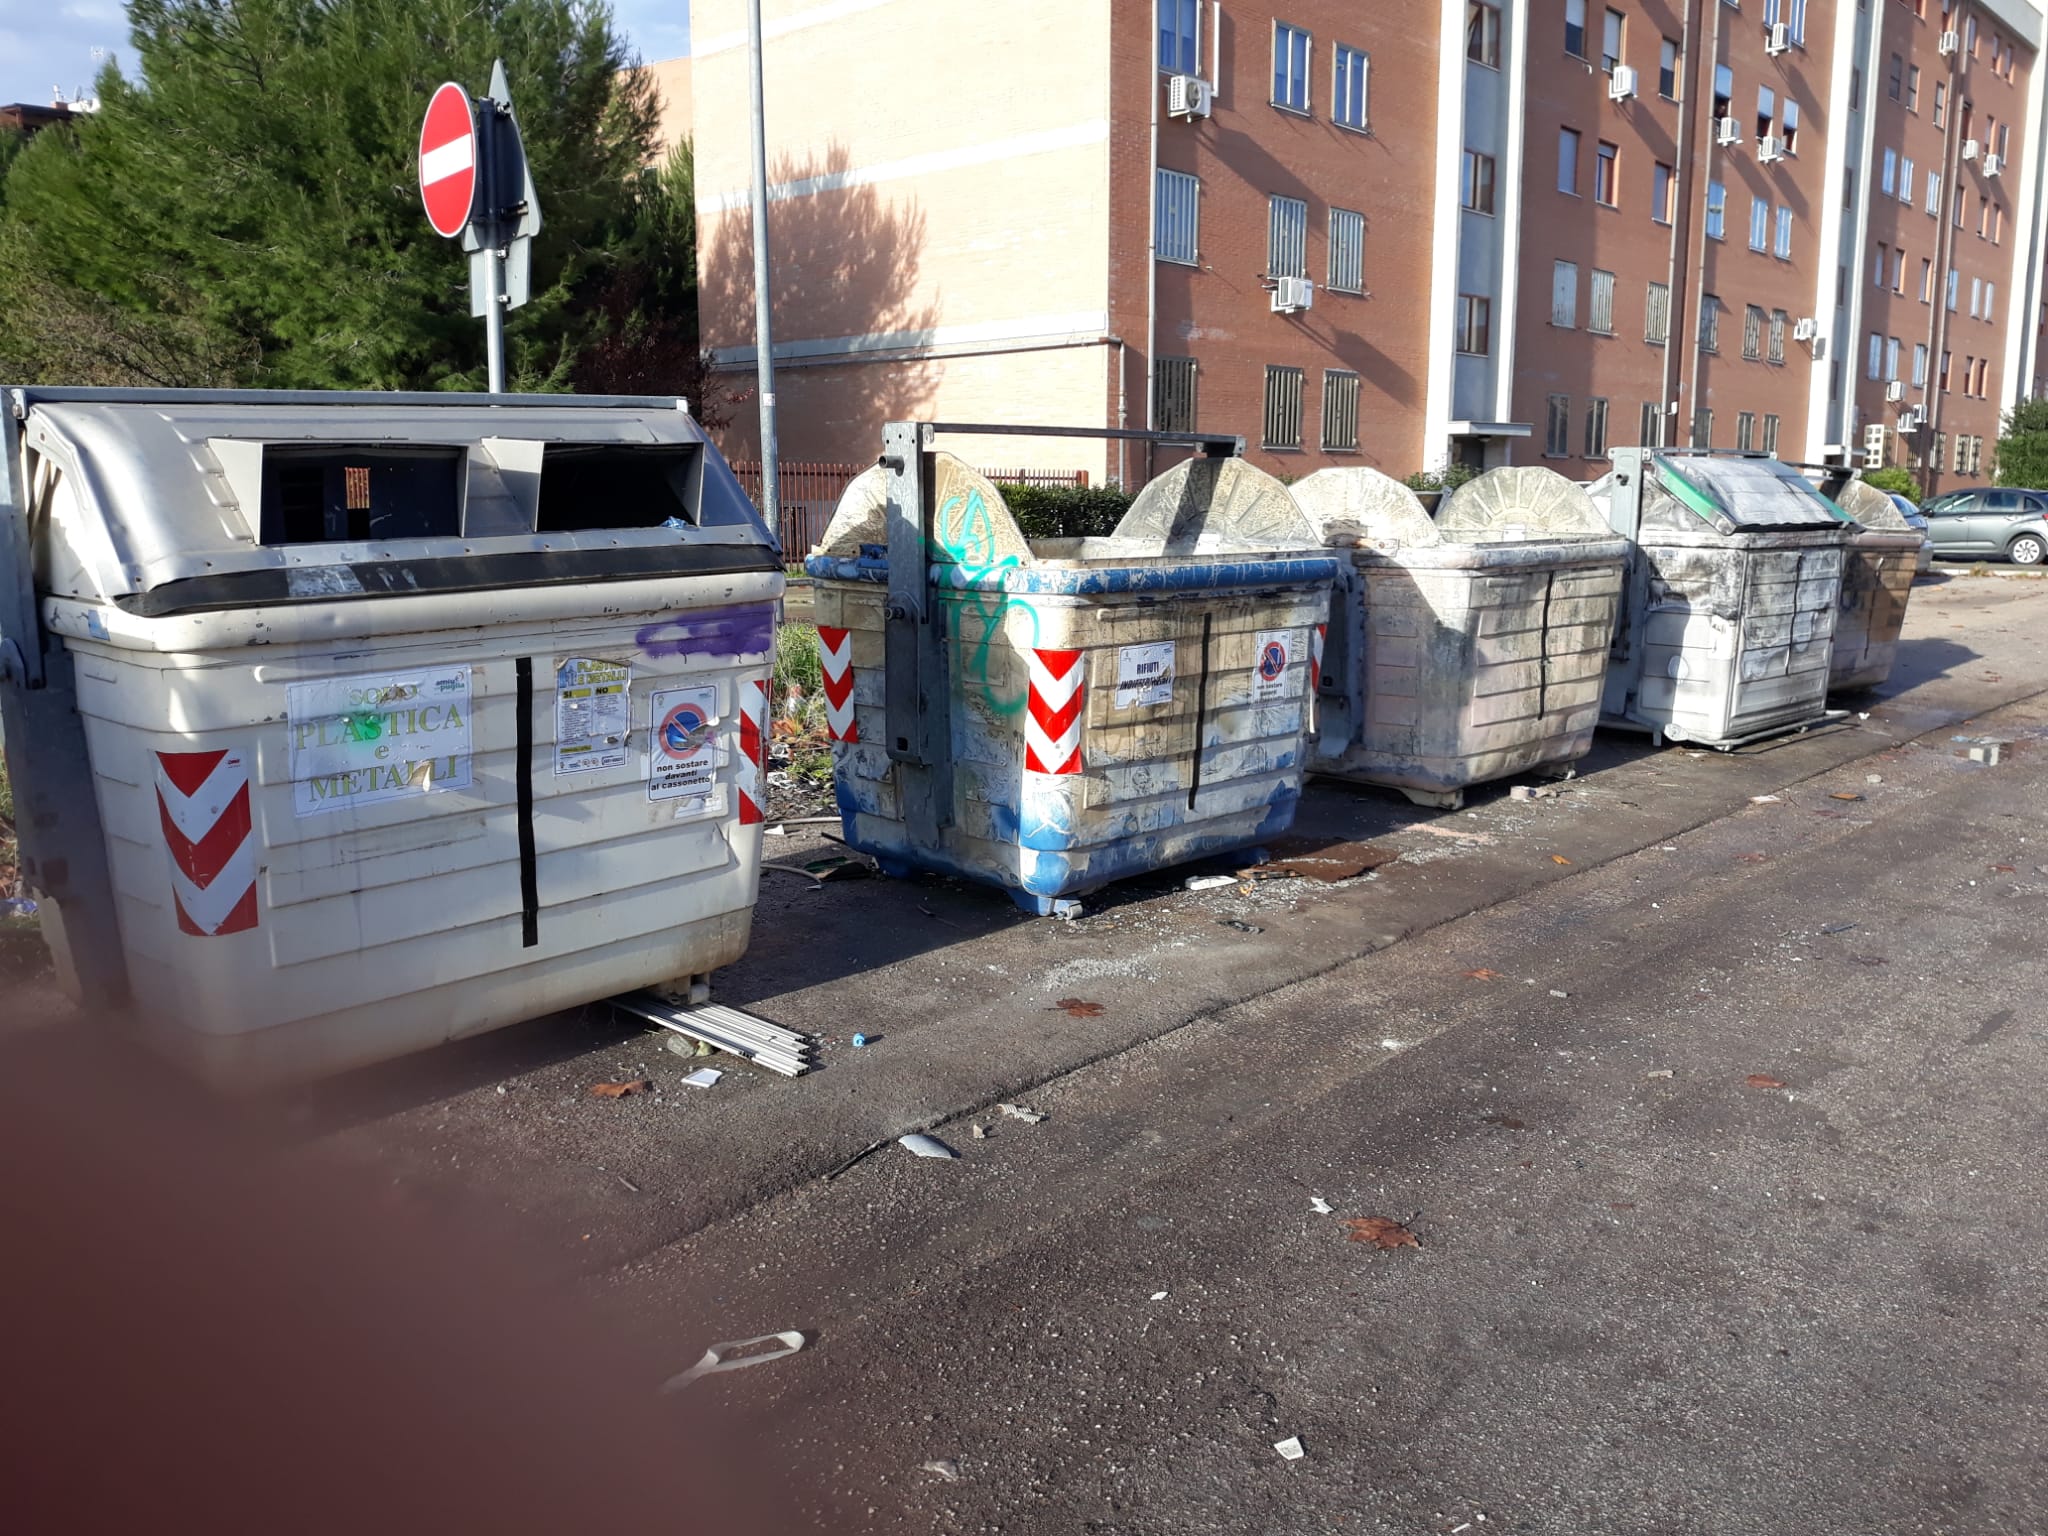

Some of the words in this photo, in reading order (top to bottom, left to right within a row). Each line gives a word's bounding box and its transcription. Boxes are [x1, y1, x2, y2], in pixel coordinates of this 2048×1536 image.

[1136, 661, 1160, 675] RIFIUTI
[350, 684, 418, 706] SOO
[596, 686, 609, 695] NO
[294, 703, 464, 750] PLASTICA
[374, 744, 390, 760] e
[656, 764, 673, 772] non
[675, 759, 709, 770] sostare
[664, 769, 698, 780] davanti
[661, 776, 711, 790] cassonetto
